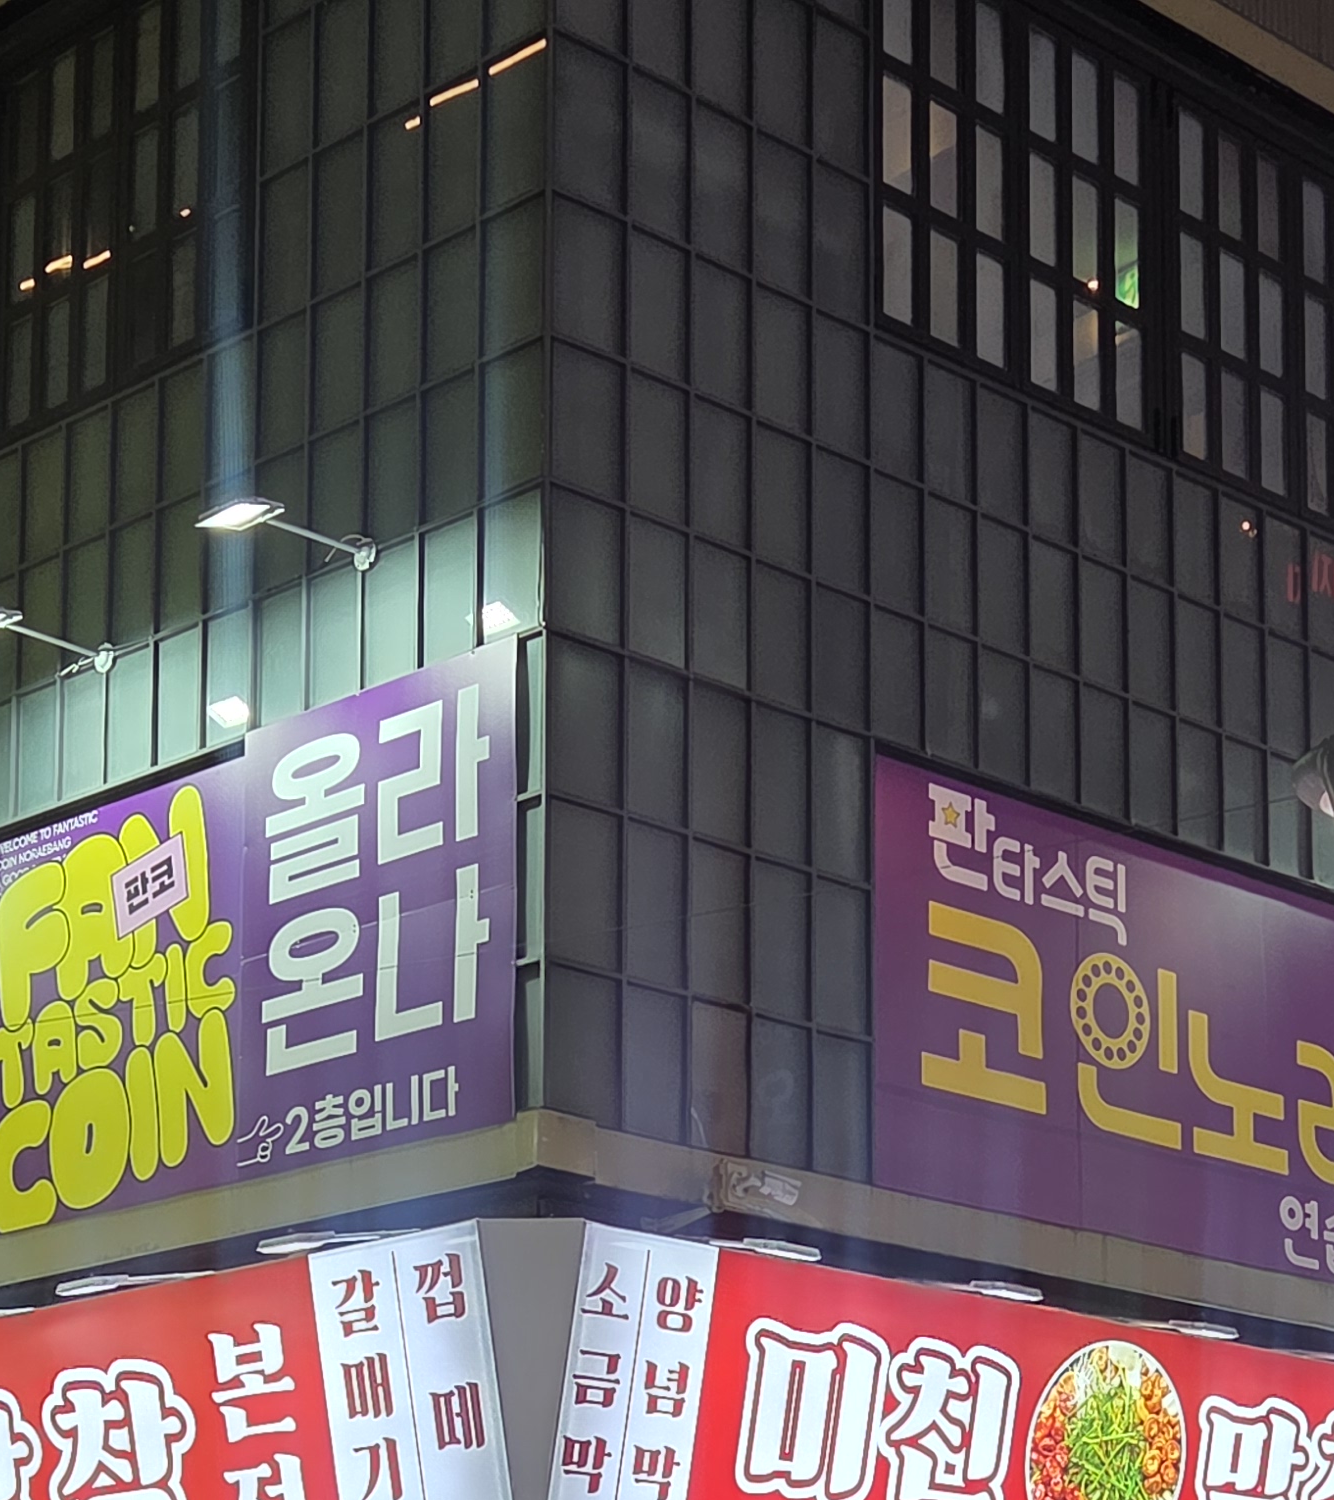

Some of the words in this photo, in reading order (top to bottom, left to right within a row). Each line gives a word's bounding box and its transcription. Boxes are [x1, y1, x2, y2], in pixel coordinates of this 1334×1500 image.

[39, 826, 52, 840] TO
[53, 809, 99, 834] FANTASTIC
[266, 683, 490, 904] 올라
[124, 855, 175, 916] 판코
[928, 782, 1128, 946] 판타스틱
[261, 863, 490, 1077] 온나
[285, 1065, 459, 1156] 2층입니다
